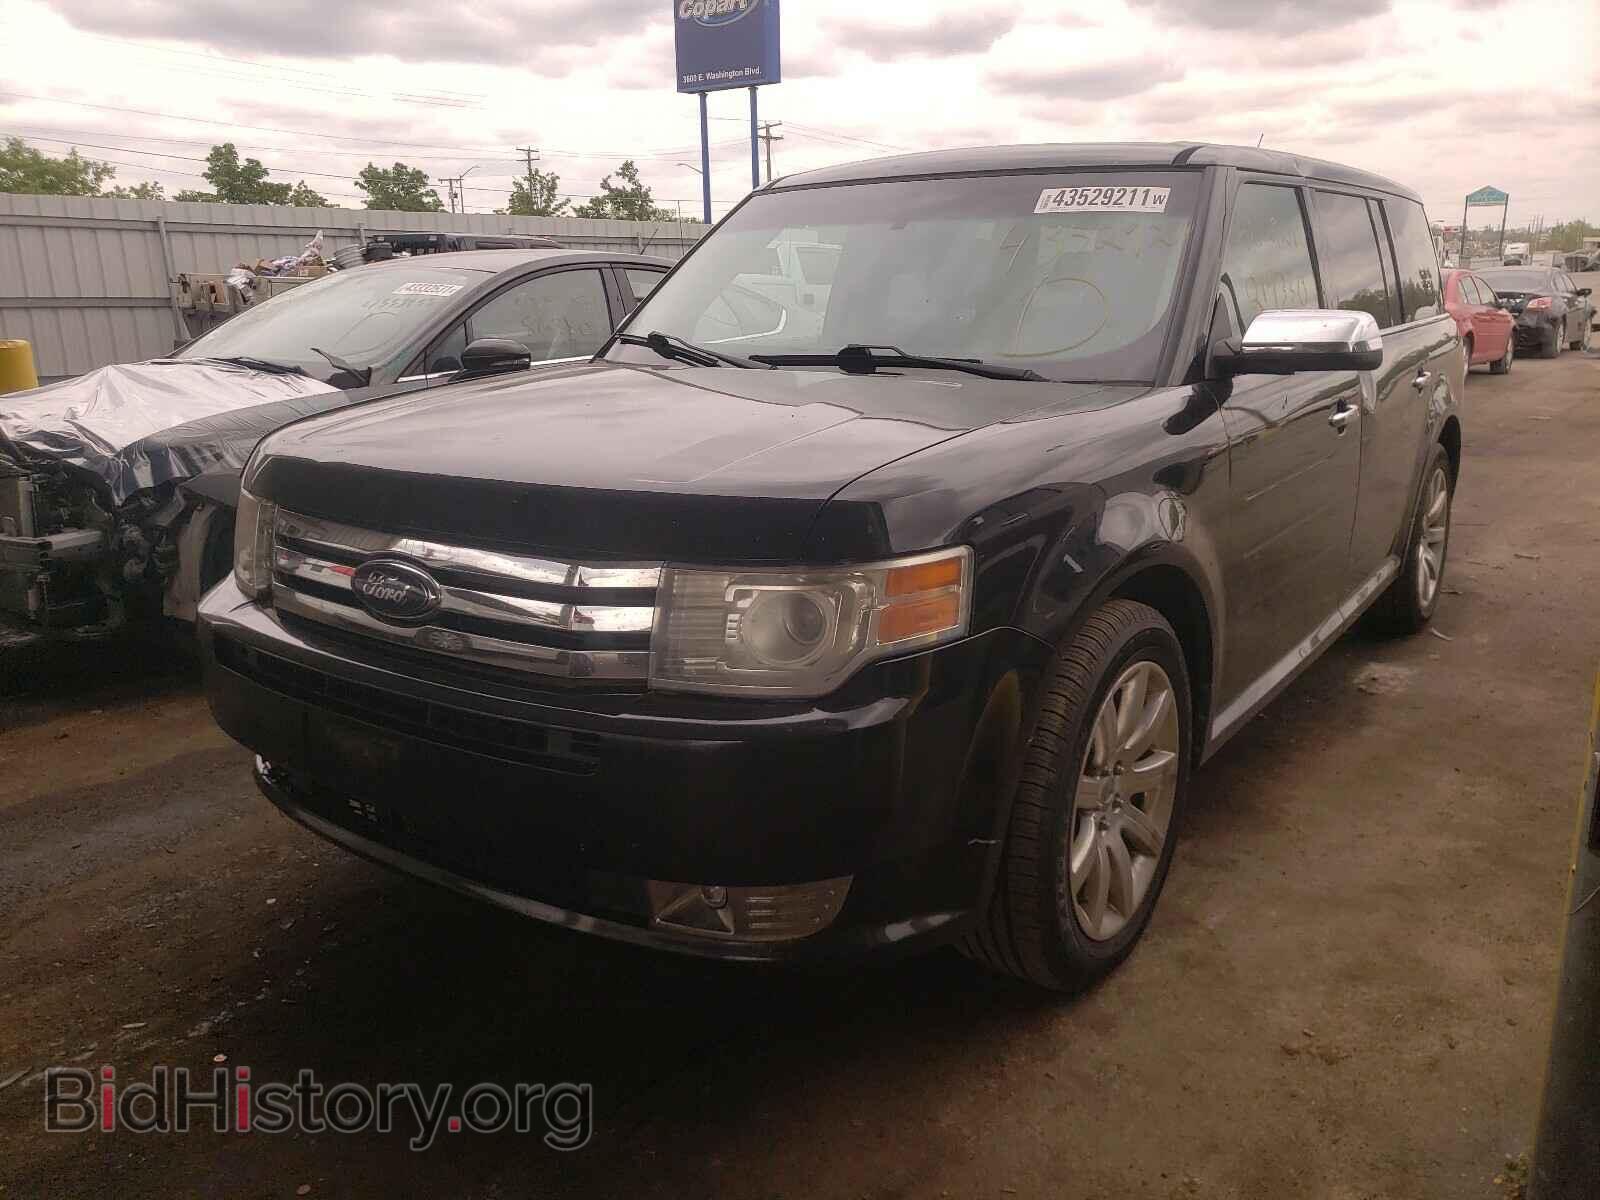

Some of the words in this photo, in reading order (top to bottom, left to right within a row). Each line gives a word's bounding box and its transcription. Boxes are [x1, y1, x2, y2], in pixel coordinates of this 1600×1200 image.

[706, 69, 743, 80] Washington
[744, 66, 762, 75] Blvd.
[1052, 188, 1151, 207] 43529211
[363, 571, 408, 606] Ford
